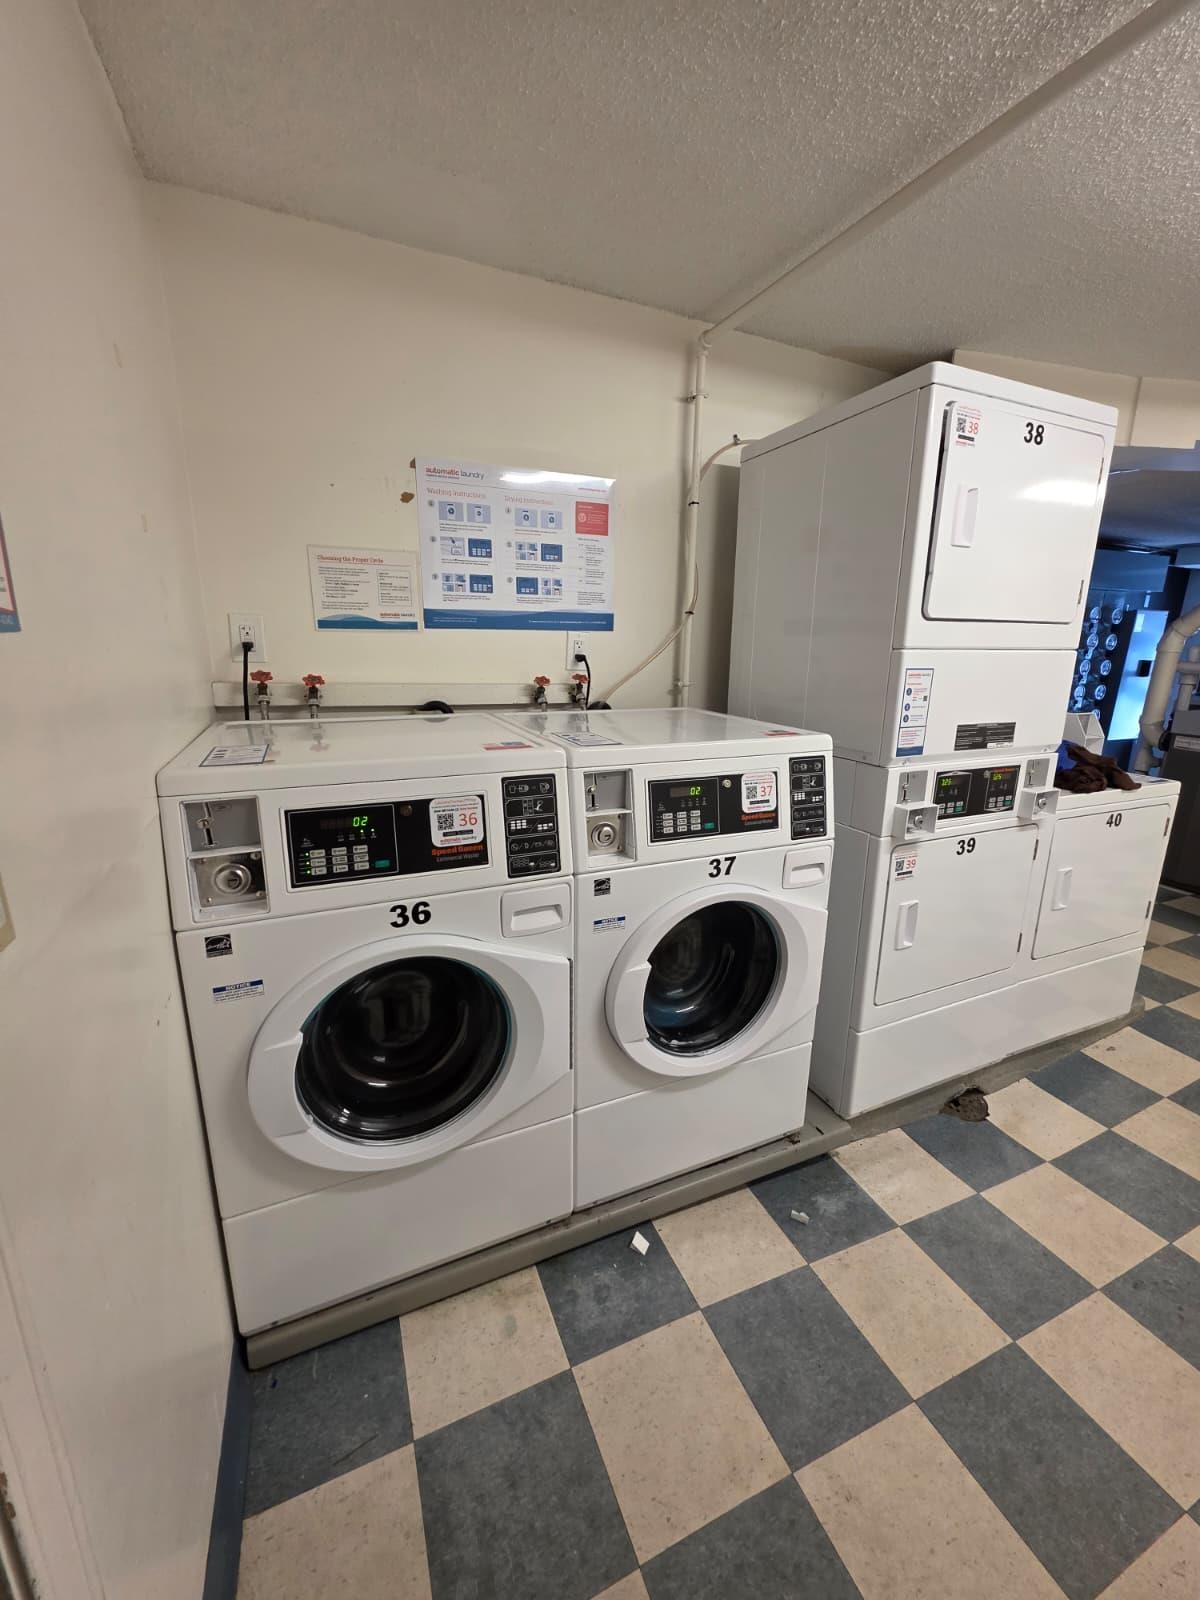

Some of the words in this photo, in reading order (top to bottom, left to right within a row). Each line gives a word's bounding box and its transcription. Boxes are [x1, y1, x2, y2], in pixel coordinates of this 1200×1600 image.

[967, 421, 979, 434] 38
[1023, 422, 1045, 445] 38
[425, 466, 460, 476] automatic
[460, 470, 485, 481] laundry
[690, 786, 701, 796] 02
[760, 785, 773, 798] 37
[353, 816, 368, 827] 02
[459, 812, 478, 827] 36
[1106, 813, 1123, 828] 40
[956, 837, 976, 855] 39
[708, 855, 737, 878] 37
[905, 859, 917, 869] 39
[389, 901, 431, 928] 36
